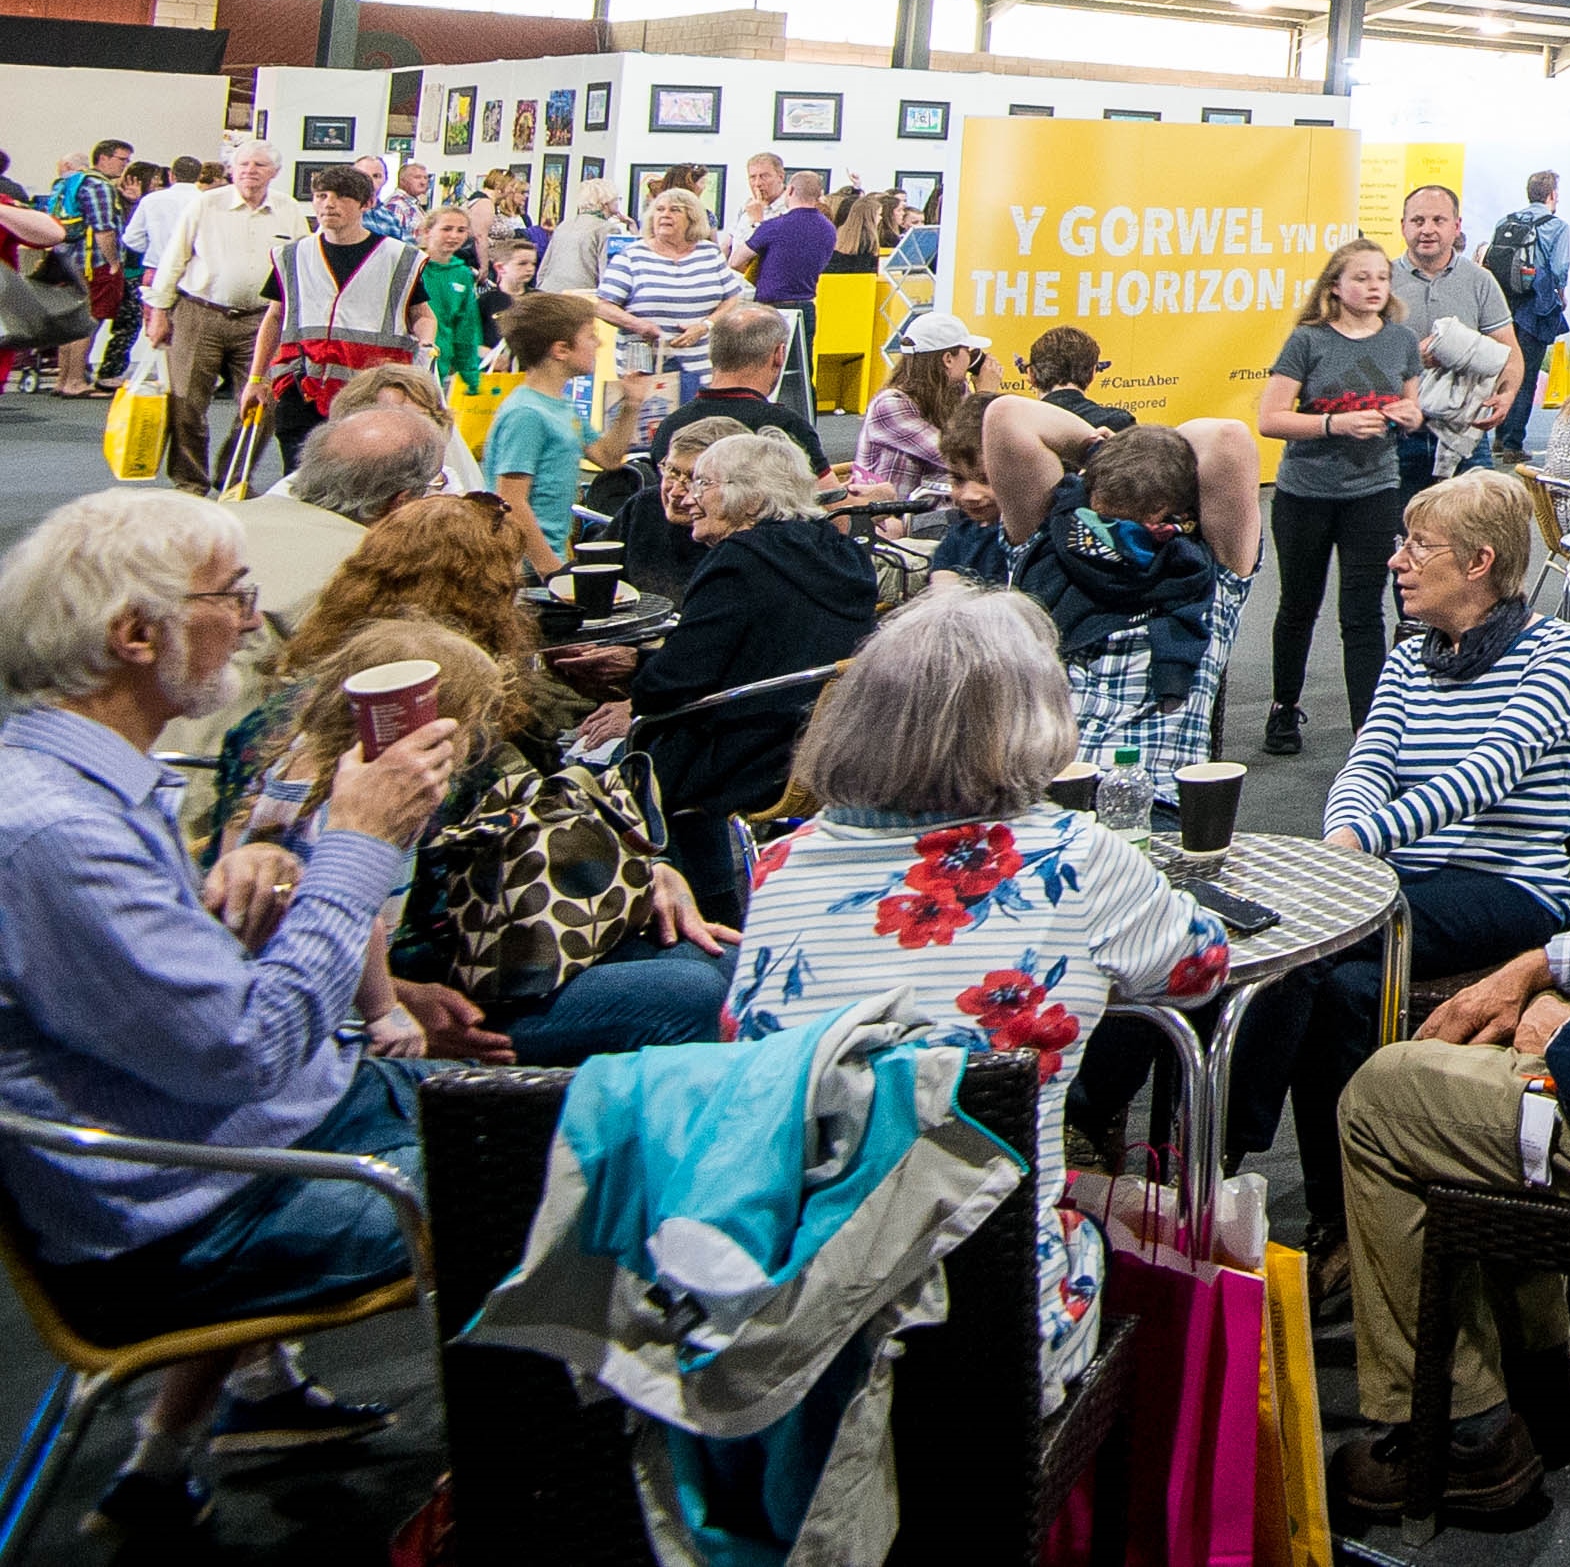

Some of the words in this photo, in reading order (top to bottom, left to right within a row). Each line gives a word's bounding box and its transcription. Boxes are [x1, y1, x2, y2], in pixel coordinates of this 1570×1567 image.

[1010, 206, 1046, 256] Y
[1058, 206, 1274, 257] GORWEL
[1279, 224, 1316, 253] YN
[970, 270, 1061, 317] THE
[1077, 268, 1285, 316] HORIZON
[1100, 375, 1180, 389] #CaruAber
[1228, 369, 1273, 381] #TheH
